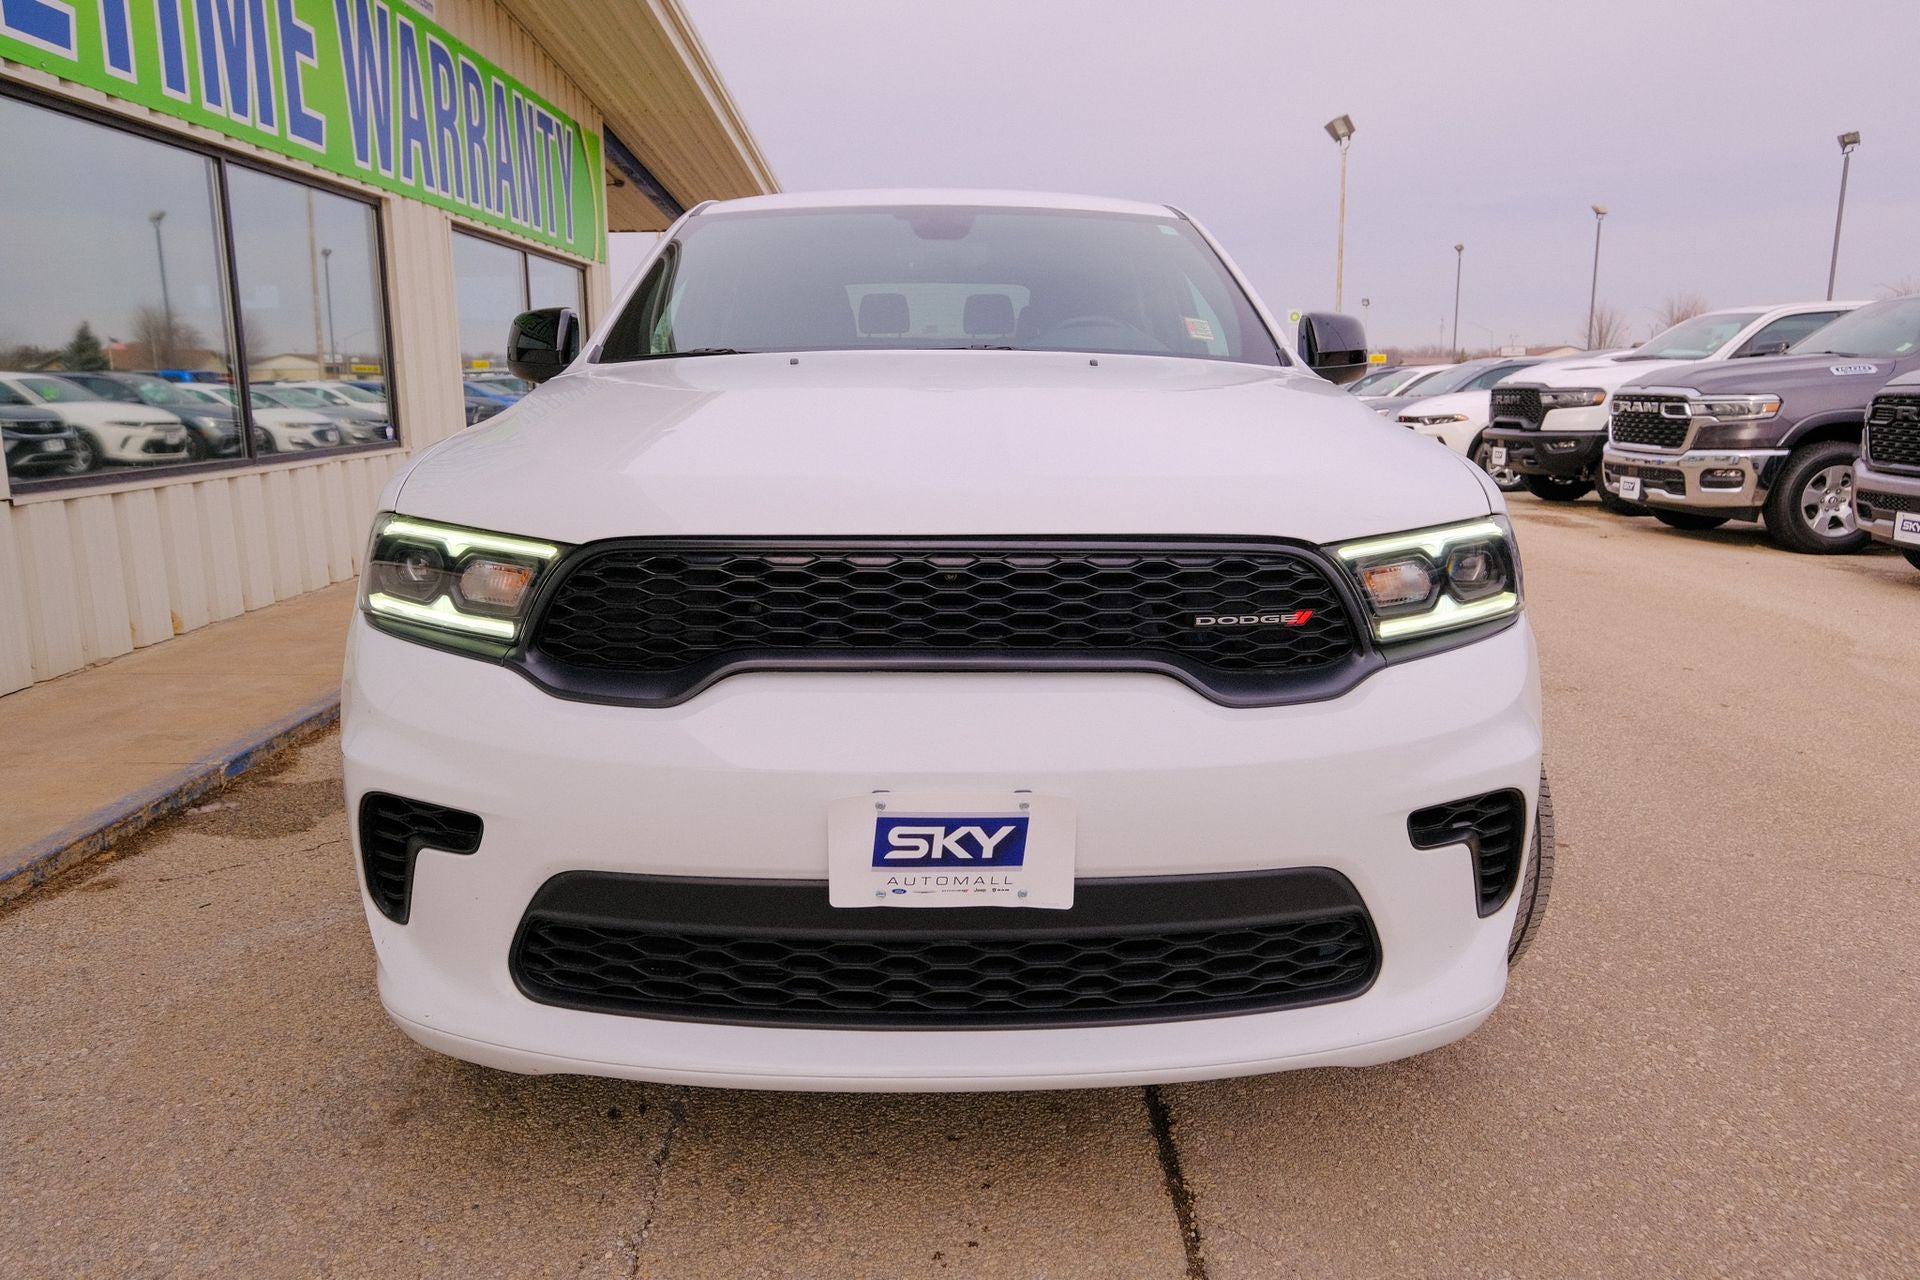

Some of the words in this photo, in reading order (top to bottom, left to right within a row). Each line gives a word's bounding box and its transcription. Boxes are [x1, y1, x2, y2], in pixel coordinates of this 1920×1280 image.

[333, 0, 574, 244] WARRANTY
[1618, 400, 1659, 413] RAM
[1195, 613, 1299, 626] DODGE
[883, 825, 1017, 859] SKY
[886, 875, 1014, 886] AUTOMALL
